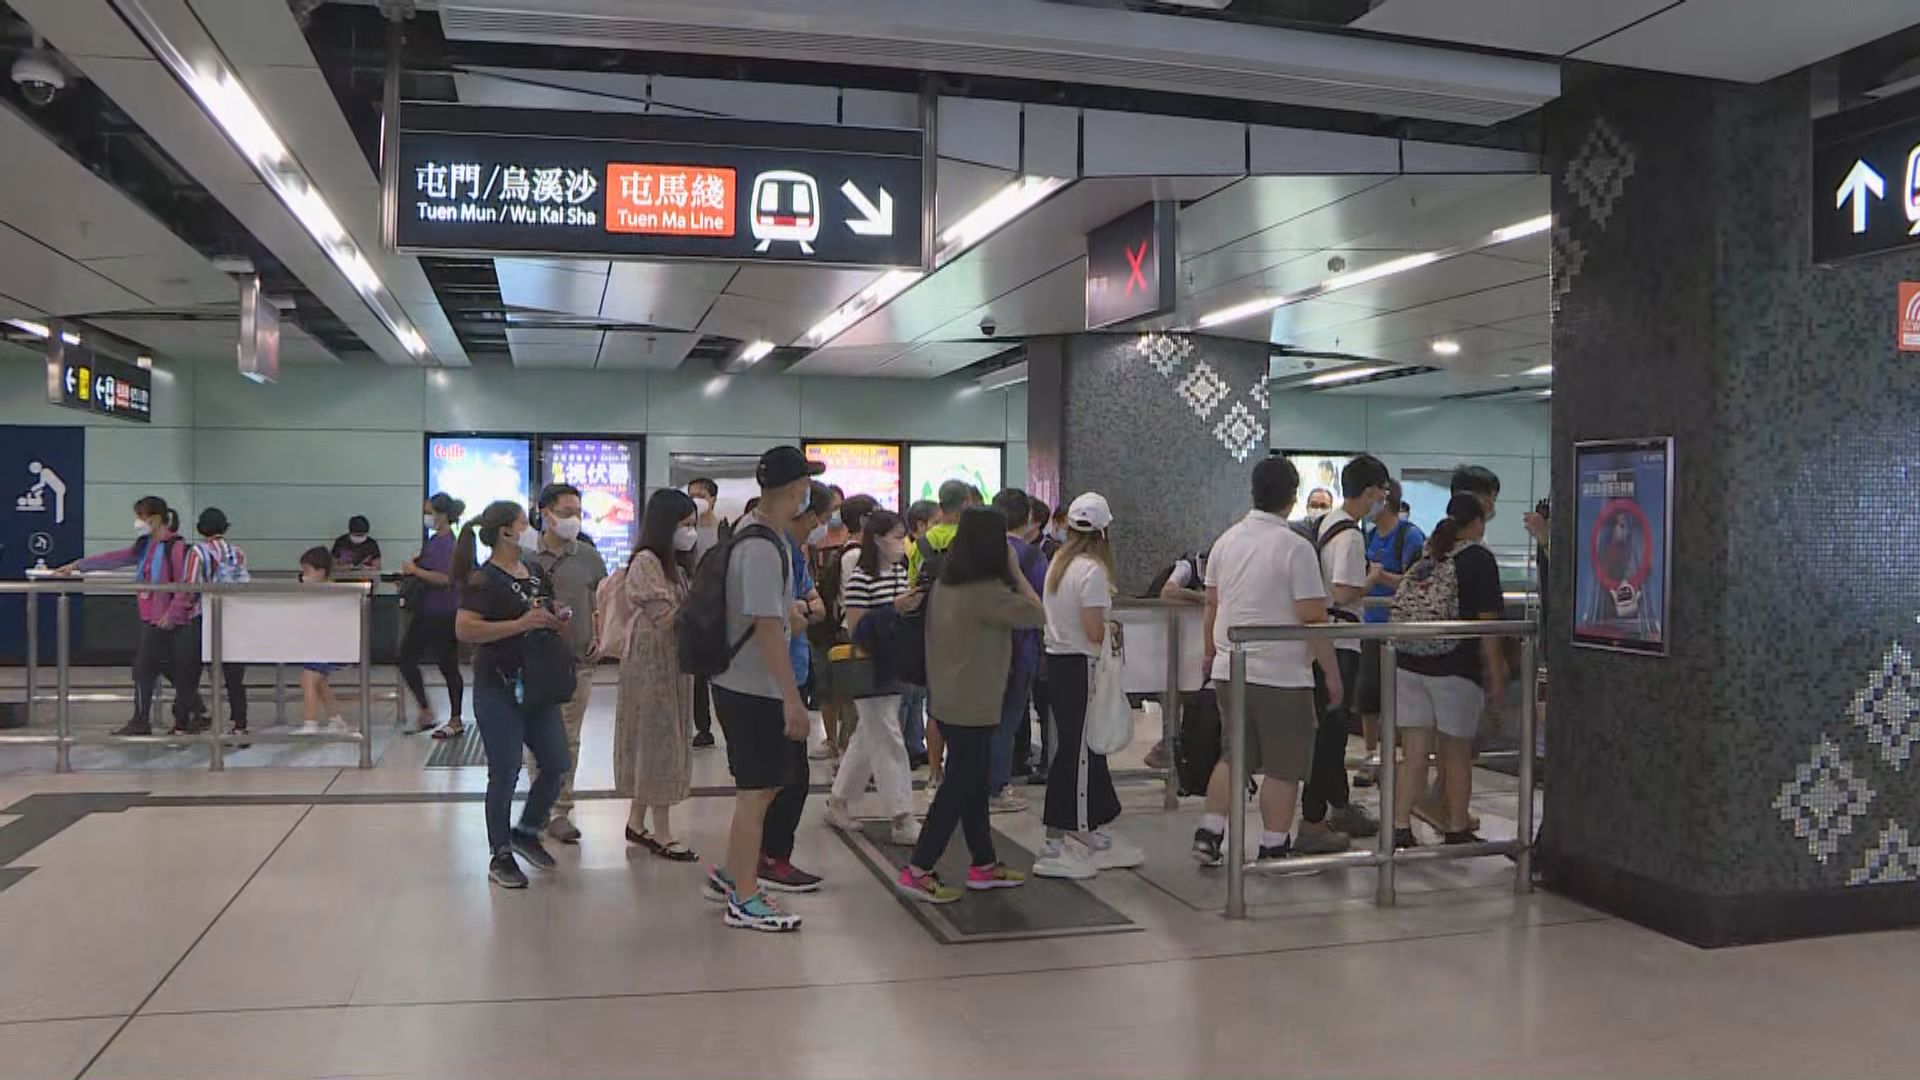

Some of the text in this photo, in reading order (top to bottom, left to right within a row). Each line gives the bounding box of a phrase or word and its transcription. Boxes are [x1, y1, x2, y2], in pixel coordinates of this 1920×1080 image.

[417, 202, 597, 226] Tuen Mun / Wu Kai Sha
[617, 208, 725, 230] Tuen Ma Line
